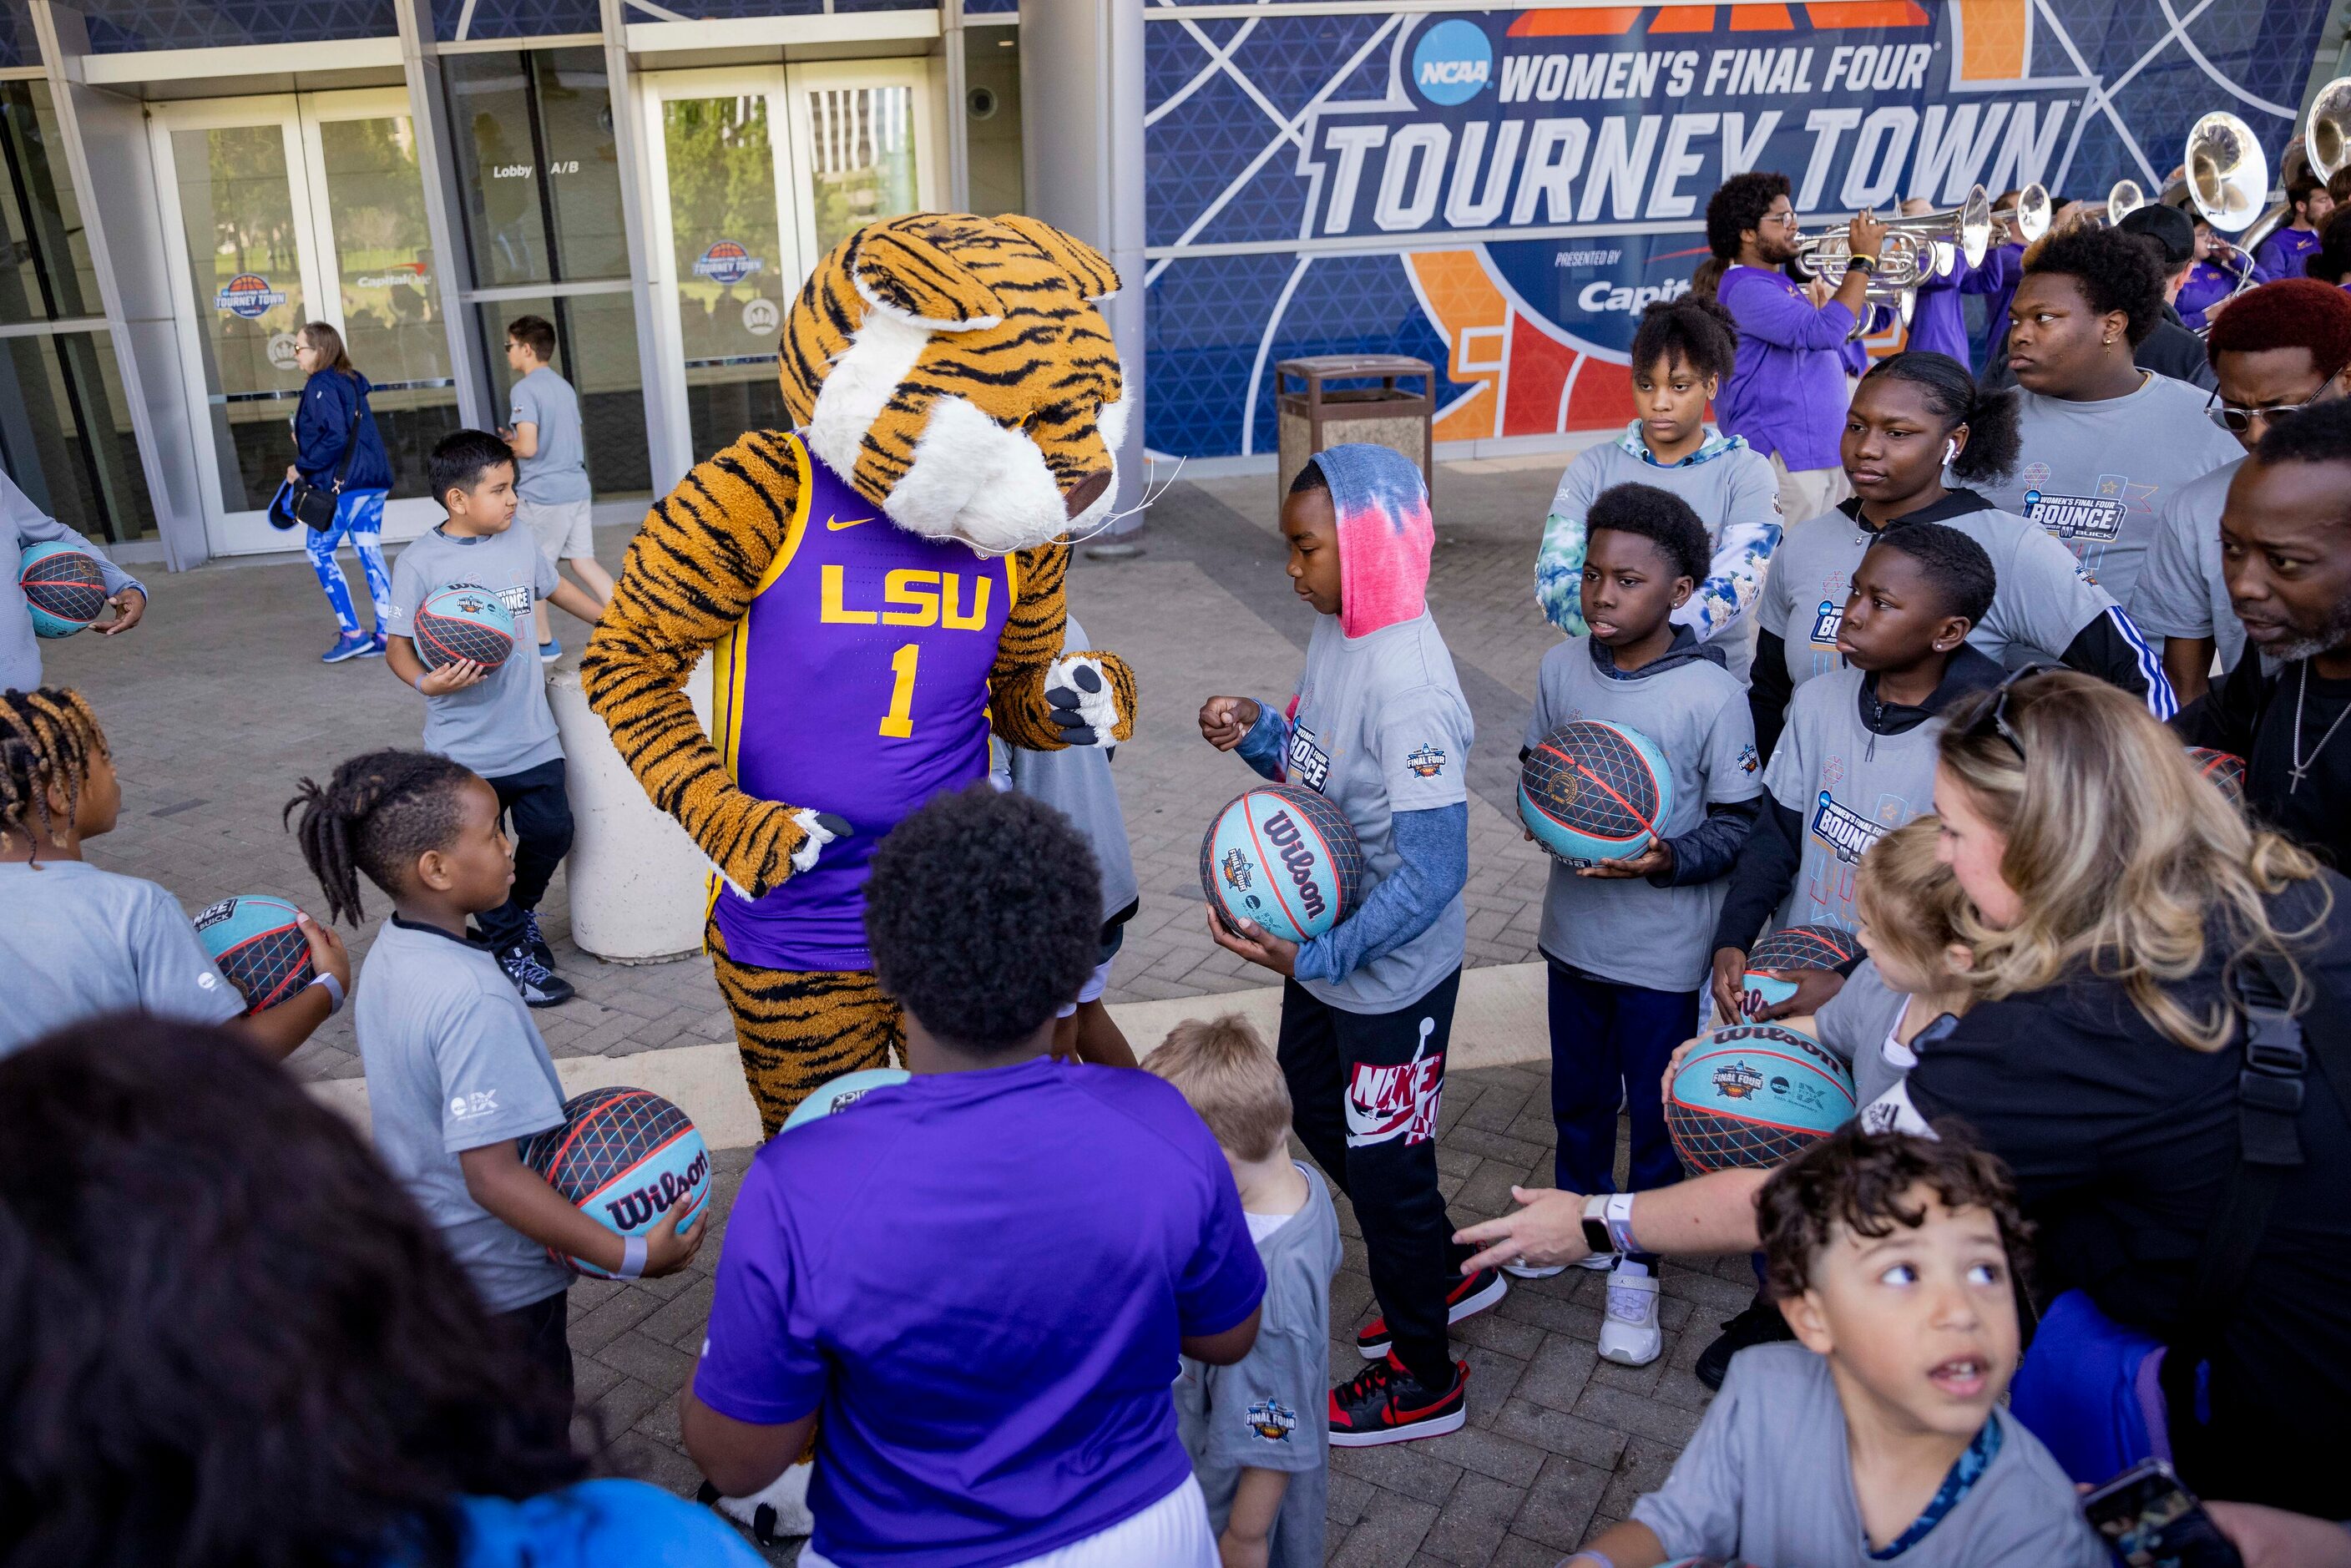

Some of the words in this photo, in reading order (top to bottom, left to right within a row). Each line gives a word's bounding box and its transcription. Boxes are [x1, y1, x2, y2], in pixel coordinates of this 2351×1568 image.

[1420, 60, 1489, 84] NCAA
[1499, 50, 1700, 104] WOMEN'S
[1703, 47, 1814, 96] FINAL
[493, 164, 533, 179] Lobby
[550, 160, 579, 175] A/B
[1324, 110, 1783, 235] TOURNEY
[1795, 100, 2070, 212] TOWN
[1555, 251, 1608, 267] PRESENTED
[1606, 250, 1623, 265] BY
[215, 295, 257, 308] TOURNEY
[258, 293, 286, 306] TOWN
[1578, 278, 1691, 316] Capit
[2040, 496, 2074, 506] WOMEN'S
[2074, 499, 2094, 508] FINAL
[2030, 503, 2117, 529] BOUNCE
[2075, 530, 2113, 539] BUICK
[501, 592, 528, 610] UNCE
[821, 564, 993, 631] LSU
[879, 644, 919, 738] 1
[1297, 726, 1315, 744] WOME
[1289, 733, 1327, 787] BOCE
[1313, 750, 1328, 766] FOUR
[1408, 756, 1428, 767] FINAL
[1428, 755, 1445, 764] FOUR
[1828, 802, 1856, 823] WOMEN'S
[1854, 818, 1873, 832] FINAL
[1818, 809, 1878, 856] BOUNC
[1229, 849, 1241, 870] FINAL
[1236, 870, 1247, 891] FOUR
[1263, 809, 1326, 920] Wilson
[200, 913, 230, 929] BUICK
[1352, 1056, 1435, 1110] NIKE
[1712, 1074, 1737, 1083] FINAL
[1737, 1075, 1762, 1089] FOUR
[605, 1150, 709, 1231] Wilson
[1246, 1413, 1271, 1424] FINAL
[1272, 1414, 1296, 1429] FOUR
